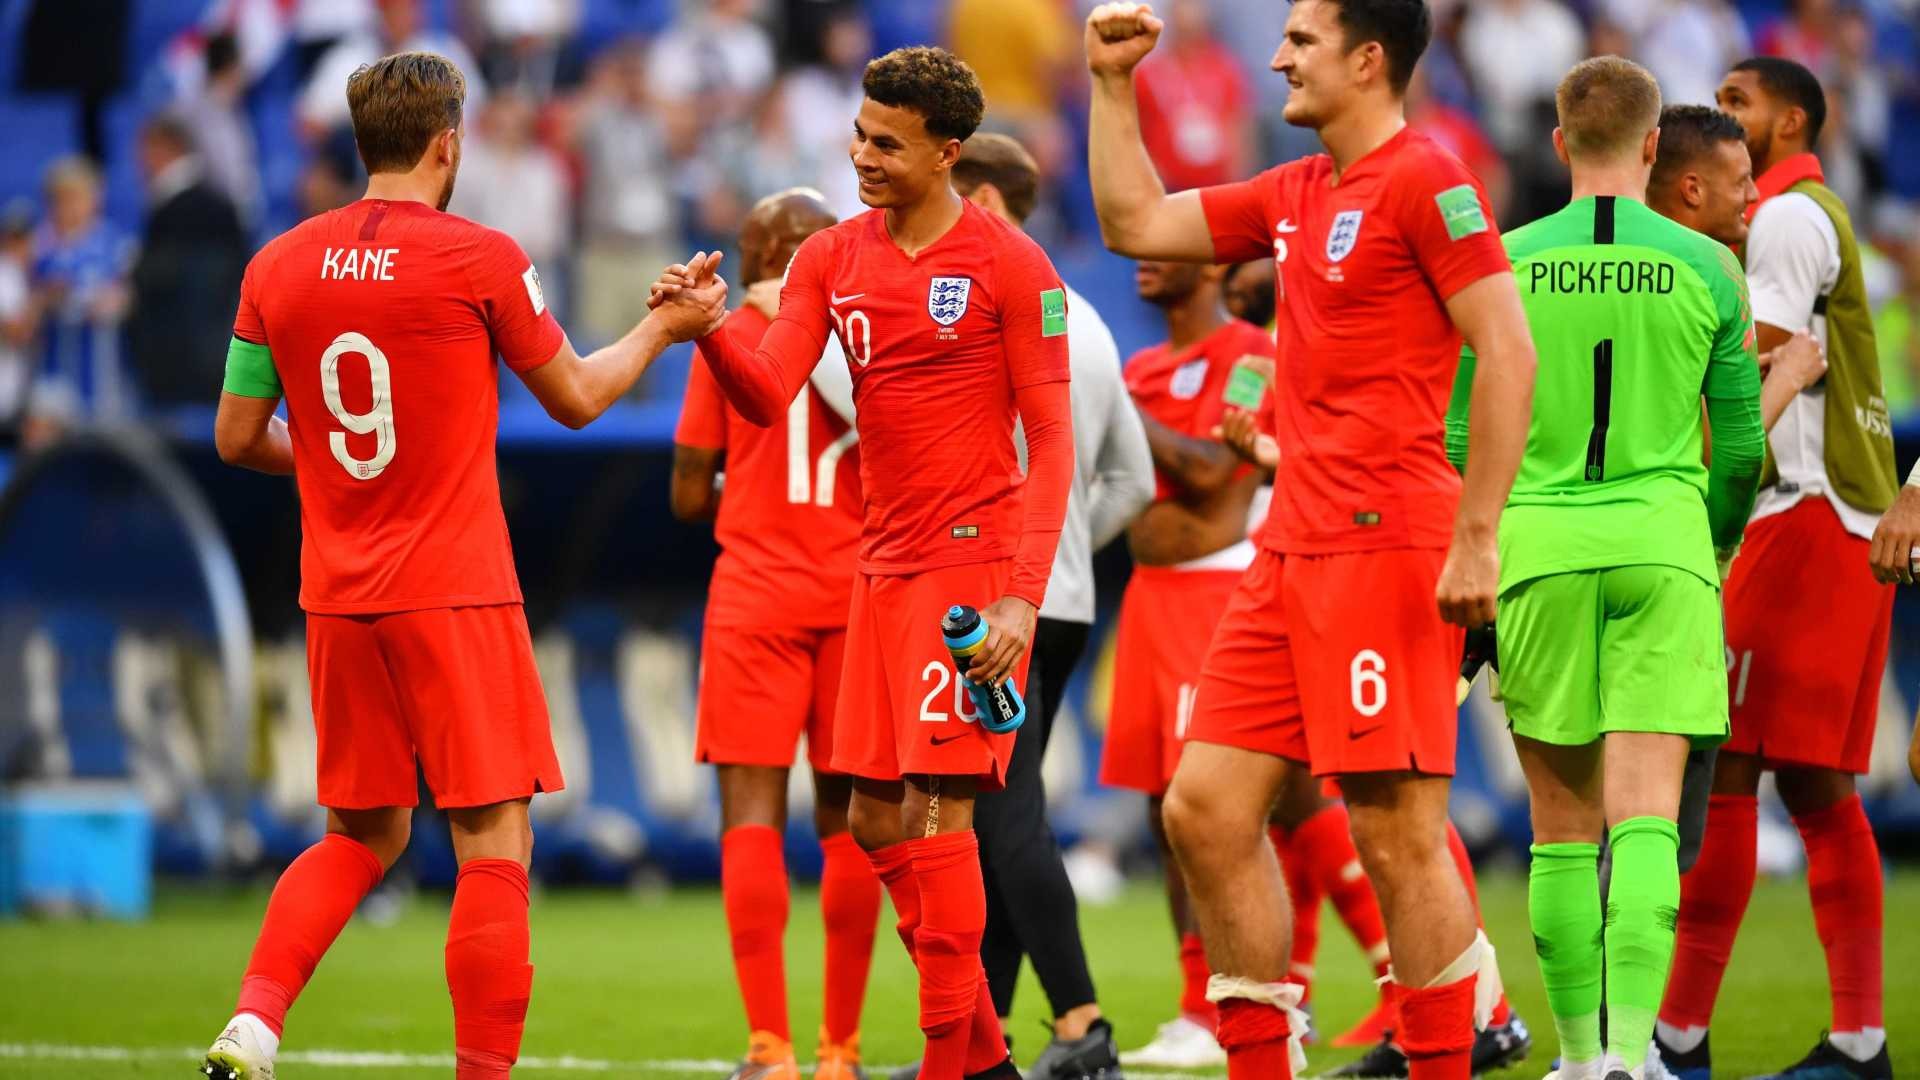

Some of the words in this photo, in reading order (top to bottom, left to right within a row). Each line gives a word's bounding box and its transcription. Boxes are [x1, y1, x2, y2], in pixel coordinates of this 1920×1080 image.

[320, 247, 399, 281] KANE
[1531, 261, 1675, 294] PICKFORD
[320, 331, 397, 480] 9
[1584, 338, 1613, 482] 1
[1350, 648, 1388, 717] 6
